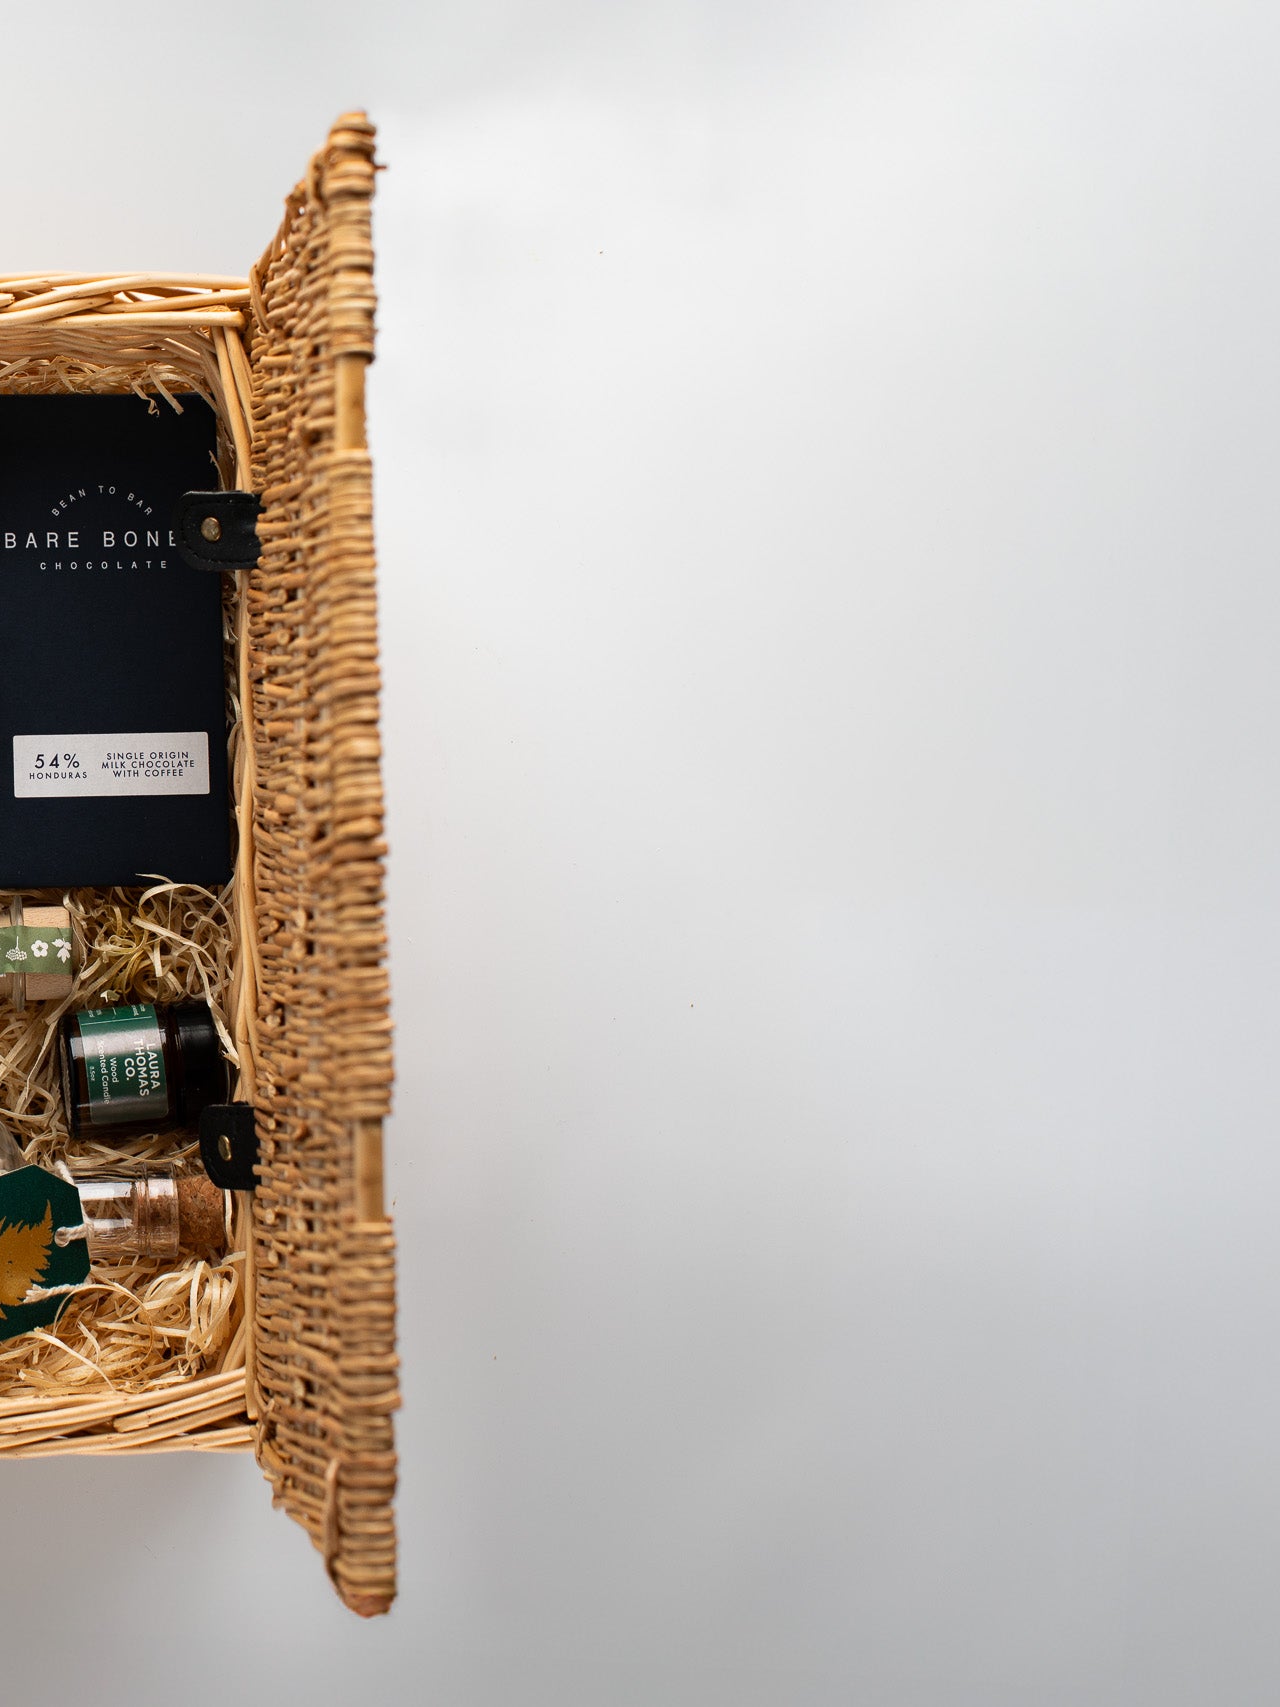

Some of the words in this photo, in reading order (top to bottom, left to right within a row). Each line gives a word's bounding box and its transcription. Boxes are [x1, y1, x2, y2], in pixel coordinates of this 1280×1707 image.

[52, 488, 86, 517] BEAN
[98, 485, 116, 495] TO
[127, 493, 153, 516] BAR
[5, 531, 80, 548] BARE
[104, 530, 176, 548] BONE
[40, 560, 167, 570] CHOCOLATE
[34, 753, 80, 769] 54%
[101, 761, 126, 769] MILK
[132, 760, 195, 768] CHOCOLATE
[107, 752, 144, 760] SINGLE
[150, 751, 189, 759] ORIGIN
[145, 769, 183, 777] COFFEE
[97, 1041, 108, 1073] Scented
[134, 1038, 149, 1096] THOMAS
[146, 1043, 160, 1089] LAURA
[110, 1058, 119, 1083] Wood
[124, 1058, 135, 1080] CO.
[101, 1076, 110, 1104] Candle
